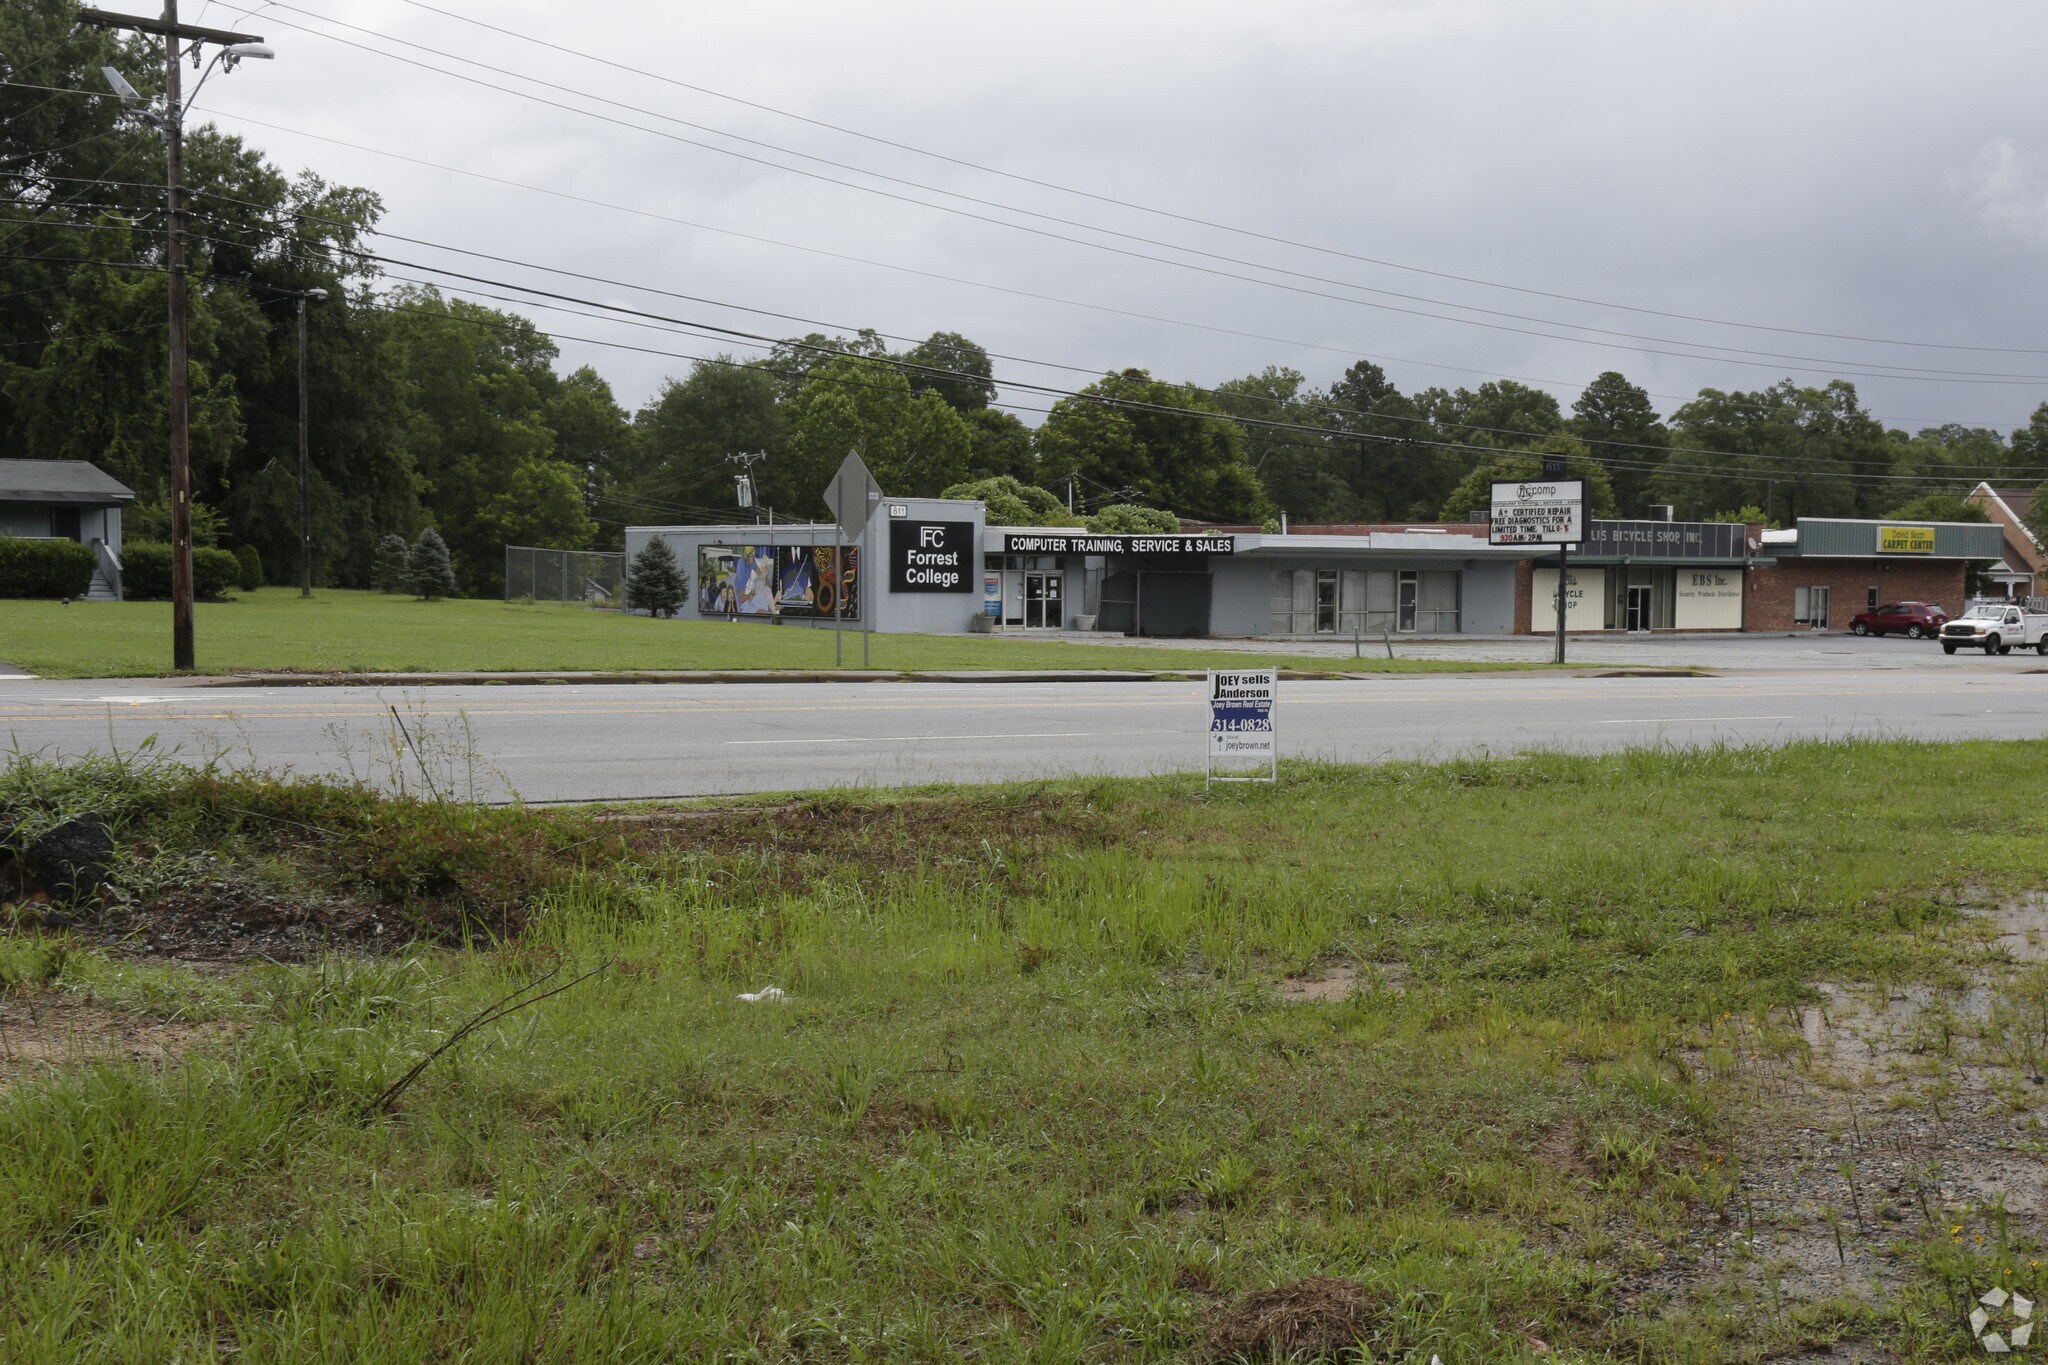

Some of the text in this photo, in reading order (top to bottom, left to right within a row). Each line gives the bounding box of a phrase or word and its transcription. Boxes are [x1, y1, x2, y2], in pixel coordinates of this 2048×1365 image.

[1546, 462, 1560, 471] 611
[893, 505, 905, 515] 611
[1512, 508, 1545, 516] CERTIFIED
[1547, 507, 1571, 515] REPAIR
[1552, 516, 1564, 524] FOR
[1591, 530, 1607, 541] LIS
[1612, 530, 1653, 542] BICYCLE
[1686, 532, 1702, 543] INC.
[1892, 530, 1908, 539] David
[1011, 537, 1231, 554] COMPUTER TRAINING, SERVICE & SALES
[1883, 539, 1934, 550] CARPET CENTER
[907, 549, 958, 566] Forrest
[906, 568, 959, 587] College
[1692, 574, 1727, 586] EBS Inc.
[1213, 674, 1270, 699] JOEY sells
[1220, 689, 1269, 698] Anderson
[1212, 700, 1271, 710] Joey Brown Real Estate
[1213, 719, 1270, 731] 314-0828
[1225, 741, 1270, 751] joeybrown.net
